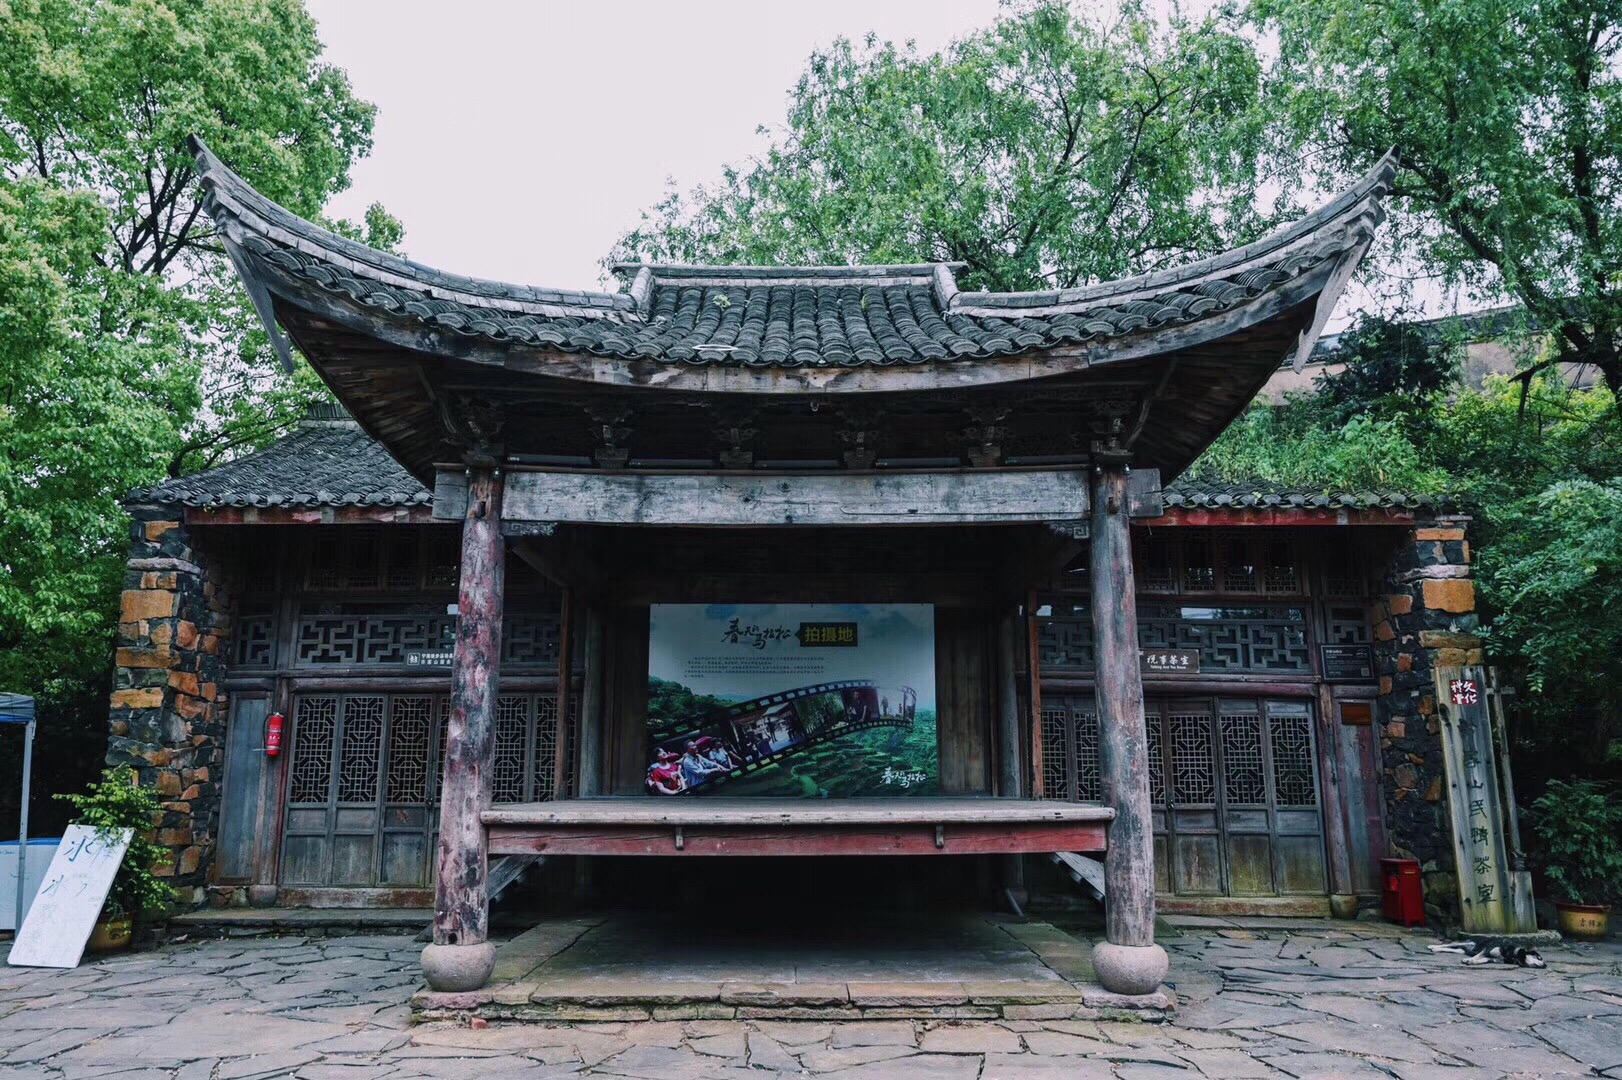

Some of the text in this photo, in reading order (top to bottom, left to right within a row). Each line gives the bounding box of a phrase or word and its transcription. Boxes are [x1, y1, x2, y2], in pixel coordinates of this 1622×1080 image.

[721, 618, 854, 650] 春天的马拉松 拍摄地
